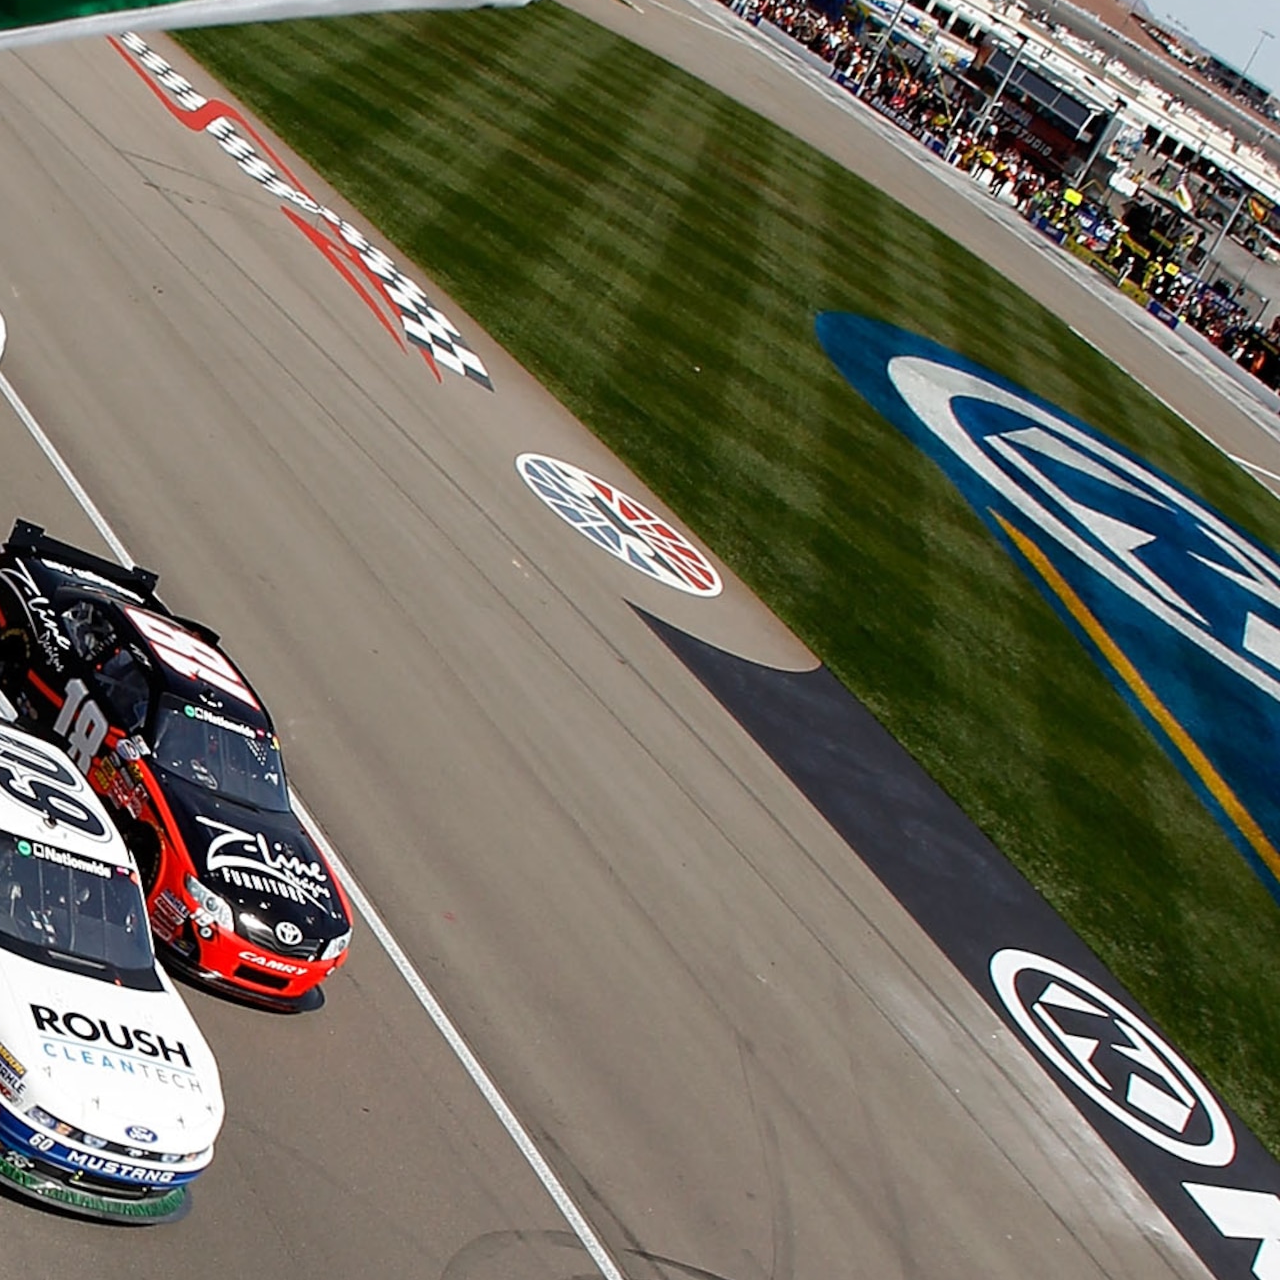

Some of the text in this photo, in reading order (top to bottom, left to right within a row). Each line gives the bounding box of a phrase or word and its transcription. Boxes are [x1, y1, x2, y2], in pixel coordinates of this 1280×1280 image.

[53, 678, 109, 775] 18
[202, 709, 257, 739] Nationwide
[45, 847, 112, 879] Nationwide
[195, 815, 327, 883] Z-Line
[221, 866, 307, 905] FURNITURE
[238, 950, 308, 976] CAMRY
[29, 1003, 192, 1068] ROUSH
[28, 1132, 55, 1152] 60
[67, 1150, 176, 1183] MUSTANG
